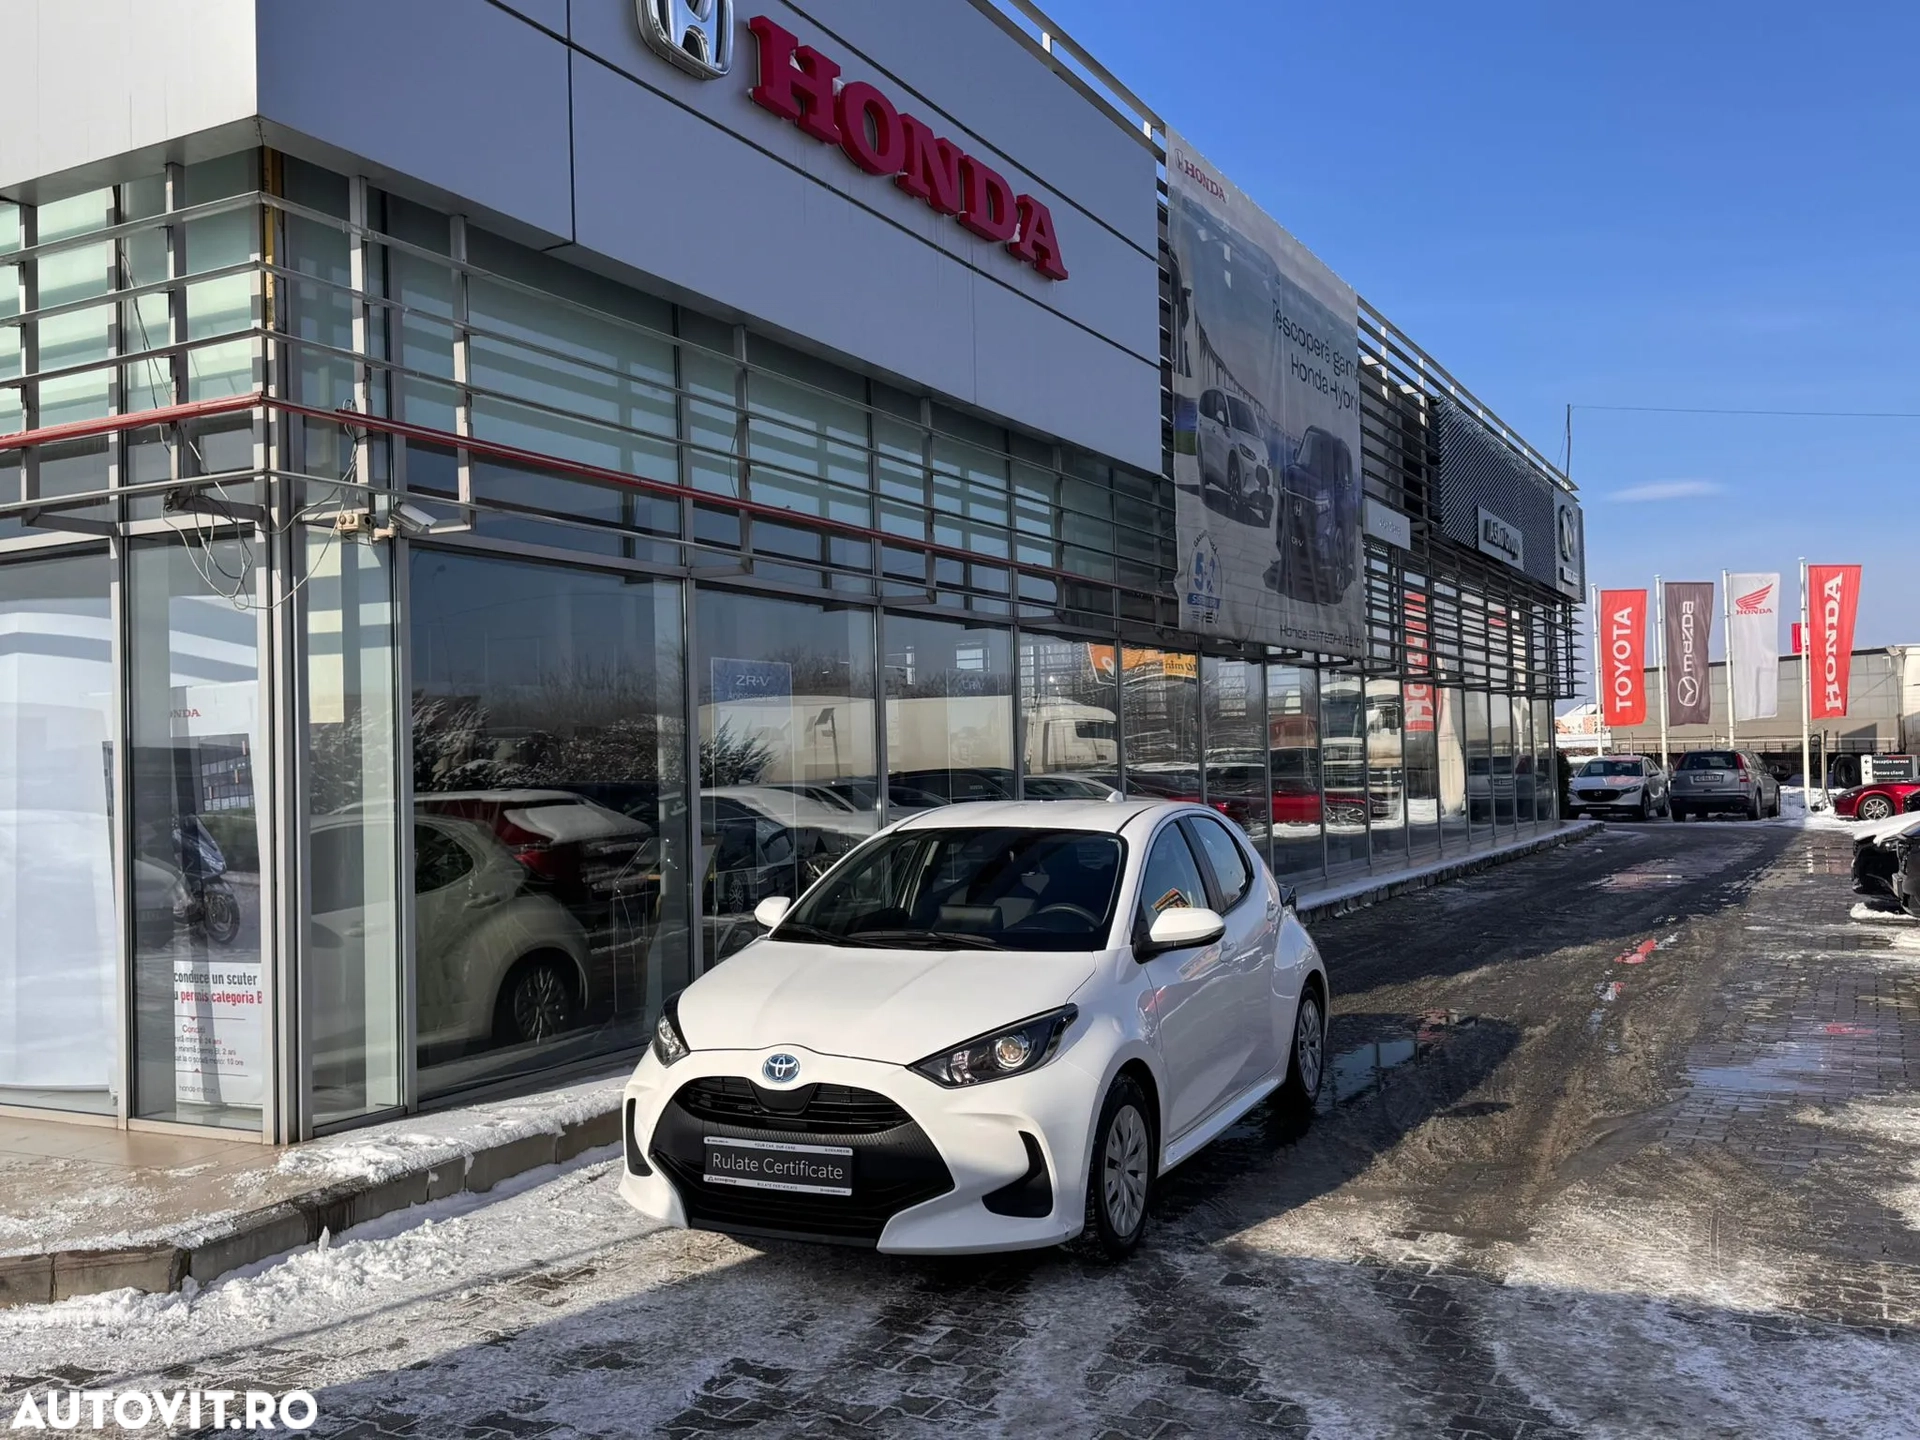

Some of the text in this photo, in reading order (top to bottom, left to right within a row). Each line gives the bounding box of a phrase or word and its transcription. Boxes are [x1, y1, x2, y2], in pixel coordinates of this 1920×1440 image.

[748, 15, 1069, 281] HONDA
[1184, 159, 1227, 204] HONDA
[1291, 353, 1329, 394] Honda
[1736, 607, 1773, 616] HONDA
[1682, 600, 1695, 672] mazda
[1824, 572, 1843, 712] HONDA
[1613, 606, 1632, 713] TOYOTA
[169, 708, 201, 718] NDA
[174, 970, 257, 986] conduce un scuter
[181, 989, 209, 1003] permis
[211, 990, 255, 1006] categoria
[713, 1153, 843, 1180] Rulate Certificate
